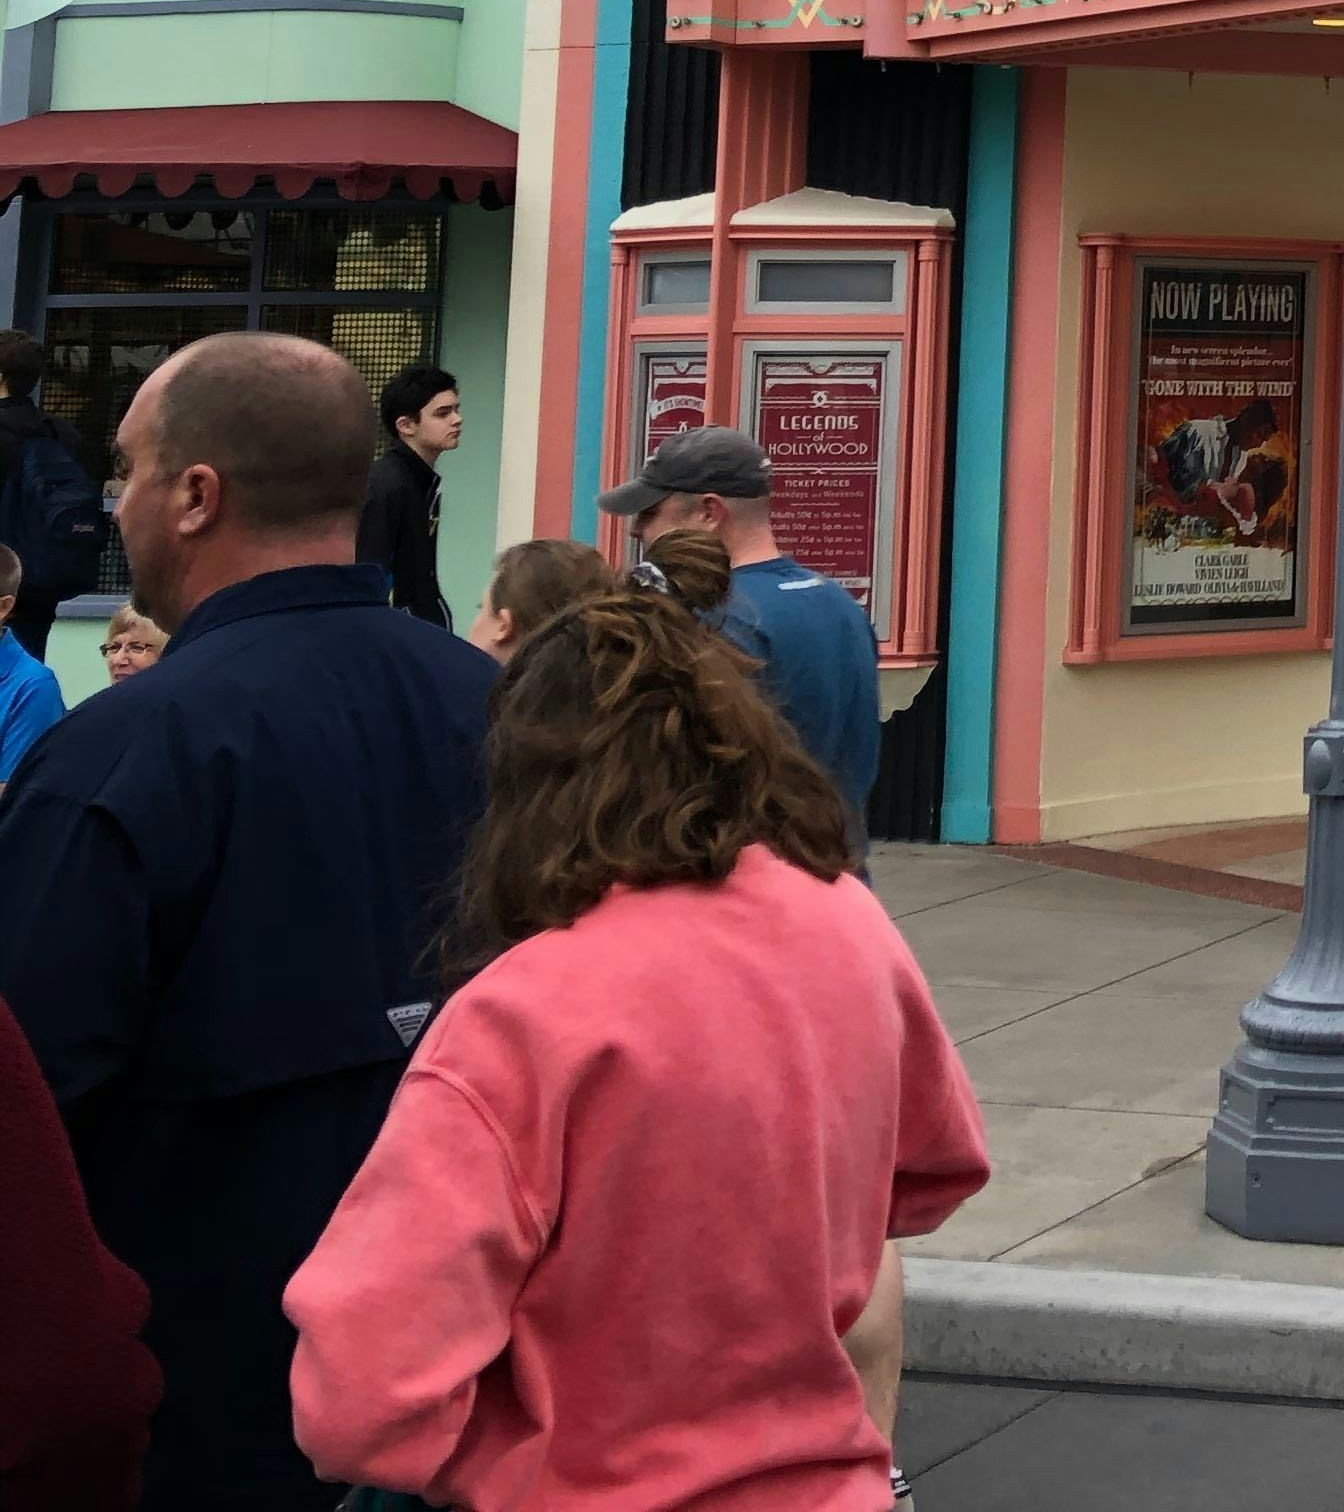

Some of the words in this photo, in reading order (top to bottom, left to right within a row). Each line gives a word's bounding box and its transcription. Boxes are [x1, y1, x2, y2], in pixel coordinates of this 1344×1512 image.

[1150, 281, 1201, 320] NOW
[1208, 284, 1293, 322] PLAYING
[1186, 380, 1224, 396] WITH
[1225, 380, 1255, 397] THE
[780, 415, 859, 430] LEGENDS
[812, 431, 825, 442] of
[768, 443, 868, 455] HOLLYWOOD
[784, 479, 815, 487] TICKET
[818, 479, 850, 487] PRICES
